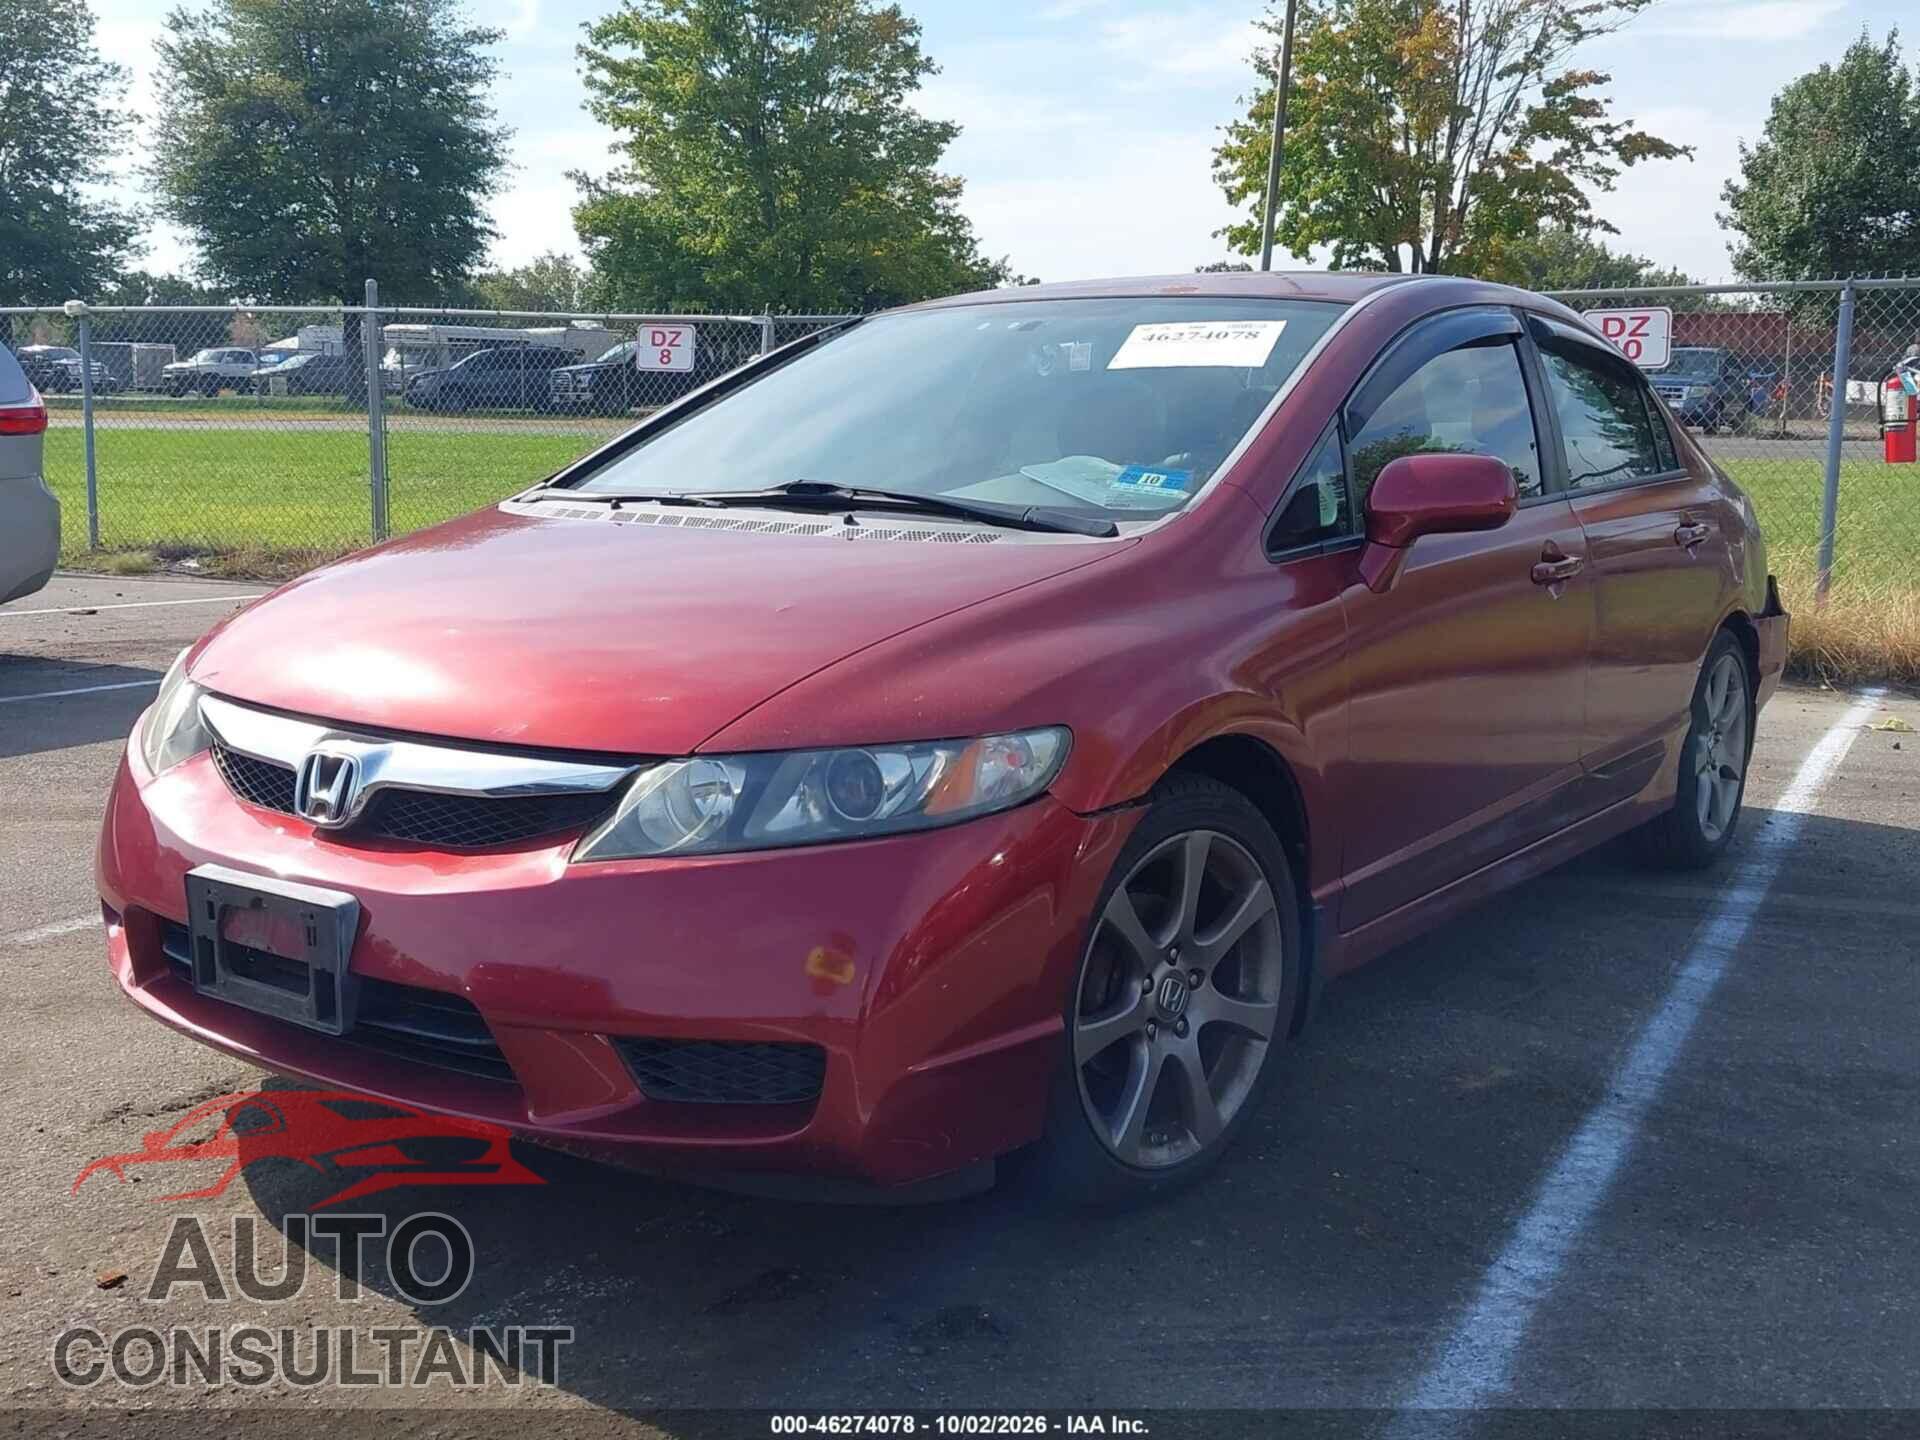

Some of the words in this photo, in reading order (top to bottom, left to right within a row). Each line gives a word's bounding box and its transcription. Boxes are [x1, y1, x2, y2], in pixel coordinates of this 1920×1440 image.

[1602, 316, 1650, 337] DZ
[651, 331, 682, 347] DZ
[1142, 331, 1261, 342] 46274078
[659, 349, 671, 365] 8
[1142, 474, 1160, 485] 10
